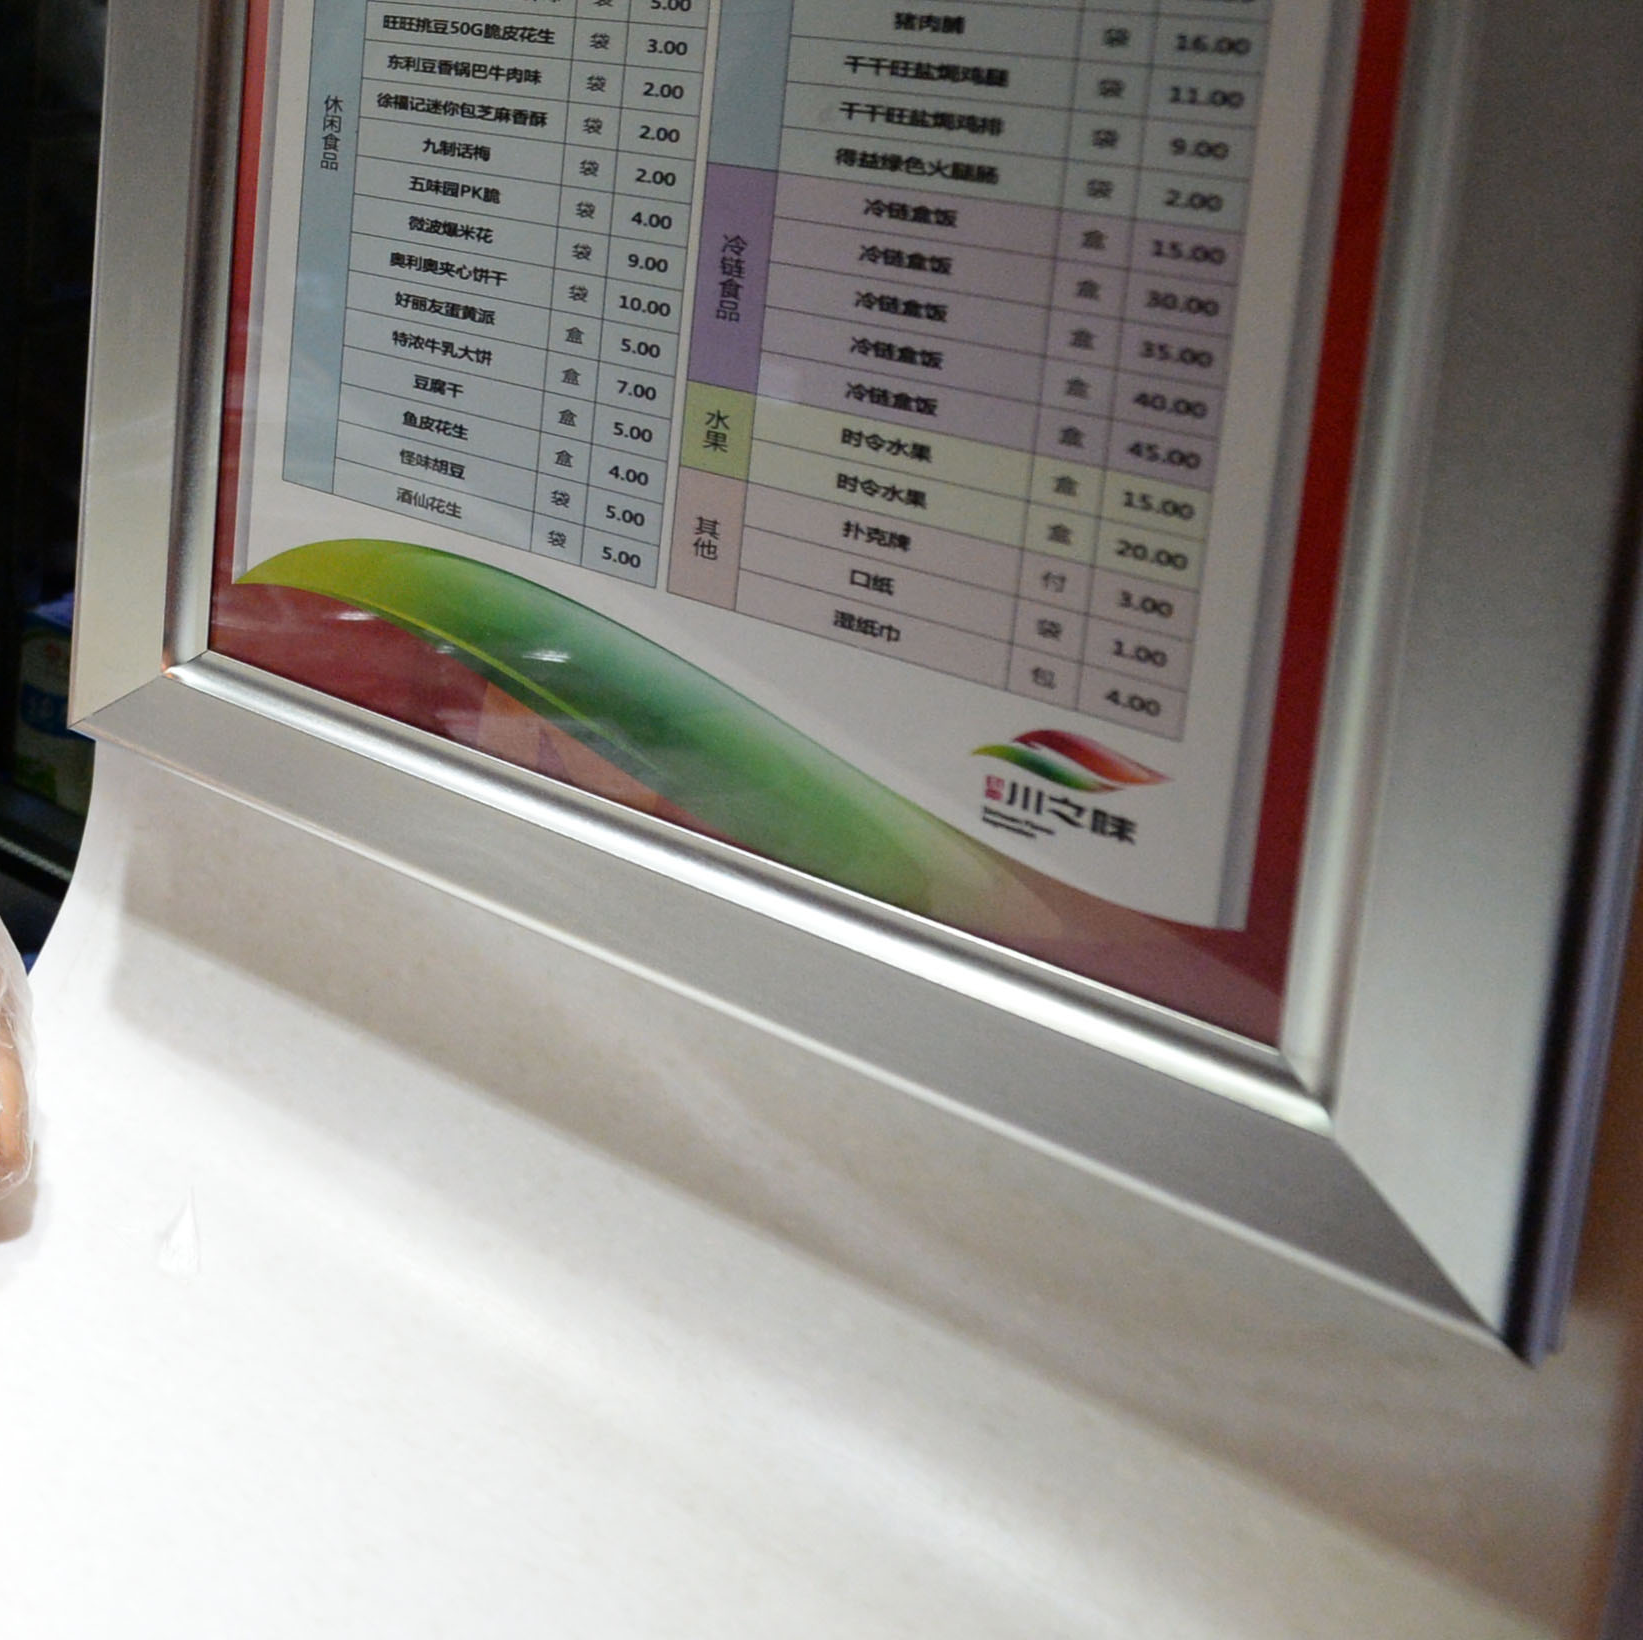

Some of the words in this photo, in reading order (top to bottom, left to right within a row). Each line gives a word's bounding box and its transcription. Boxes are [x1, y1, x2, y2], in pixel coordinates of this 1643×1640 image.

[386, 53, 543, 86] 东利豆香锅巴牛肉味
[641, 80, 686, 101] 2.00
[646, 37, 689, 57] 3.00
[319, 94, 344, 173] 休闲食品
[421, 137, 492, 163] 九制话梅
[634, 167, 678, 188] 2.00
[638, 123, 682, 145] 2.00
[630, 210, 674, 231] 4.00
[862, 198, 959, 229] 冷链盒饭
[1151, 238, 1228, 267] 15.00
[388, 251, 508, 288] 奥利奥夹心饼干
[618, 293, 672, 318] 10.00
[627, 252, 670, 274] 9.00
[714, 233, 749, 324] 冷链食品
[857, 244, 953, 277] 冷链盒饭
[1145, 289, 1221, 319] 30.00
[394, 290, 497, 326] 好丽友蛋黄派
[620, 336, 662, 360] 5.00
[853, 290, 949, 324] 冷链盒饭
[1140, 339, 1215, 370] 35.00
[391, 329, 493, 367] 特浓牛乳大饼
[616, 378, 658, 402] 7.00
[849, 336, 944, 371] 冷链盒饭
[1132, 390, 1209, 420] 40.00
[412, 373, 465, 399] 豆腐干
[612, 420, 654, 444] 5.00
[702, 409, 731, 454] 水果
[844, 381, 939, 418] 冷链盒饭
[1127, 440, 1203, 471] 45.00
[401, 409, 469, 442] 鱼皮花生
[607, 464, 650, 487] 4.00
[839, 426, 933, 464] 时令水果
[1122, 489, 1196, 522] 15.00
[395, 486, 463, 521] 酒仙花生
[601, 544, 643, 570] 5.00
[605, 503, 647, 528] 5.00
[691, 514, 720, 562] 其他
[835, 471, 928, 510] 时令水果
[1115, 538, 1190, 572] 20.00
[841, 519, 912, 554] 扑克牌
[1119, 589, 1175, 620] 3.00
[832, 608, 902, 644] 湿纸巾
[1104, 688, 1162, 718] 4.00
[1111, 638, 1169, 669] 1.00
[1006, 781, 1138, 846] 川之味
